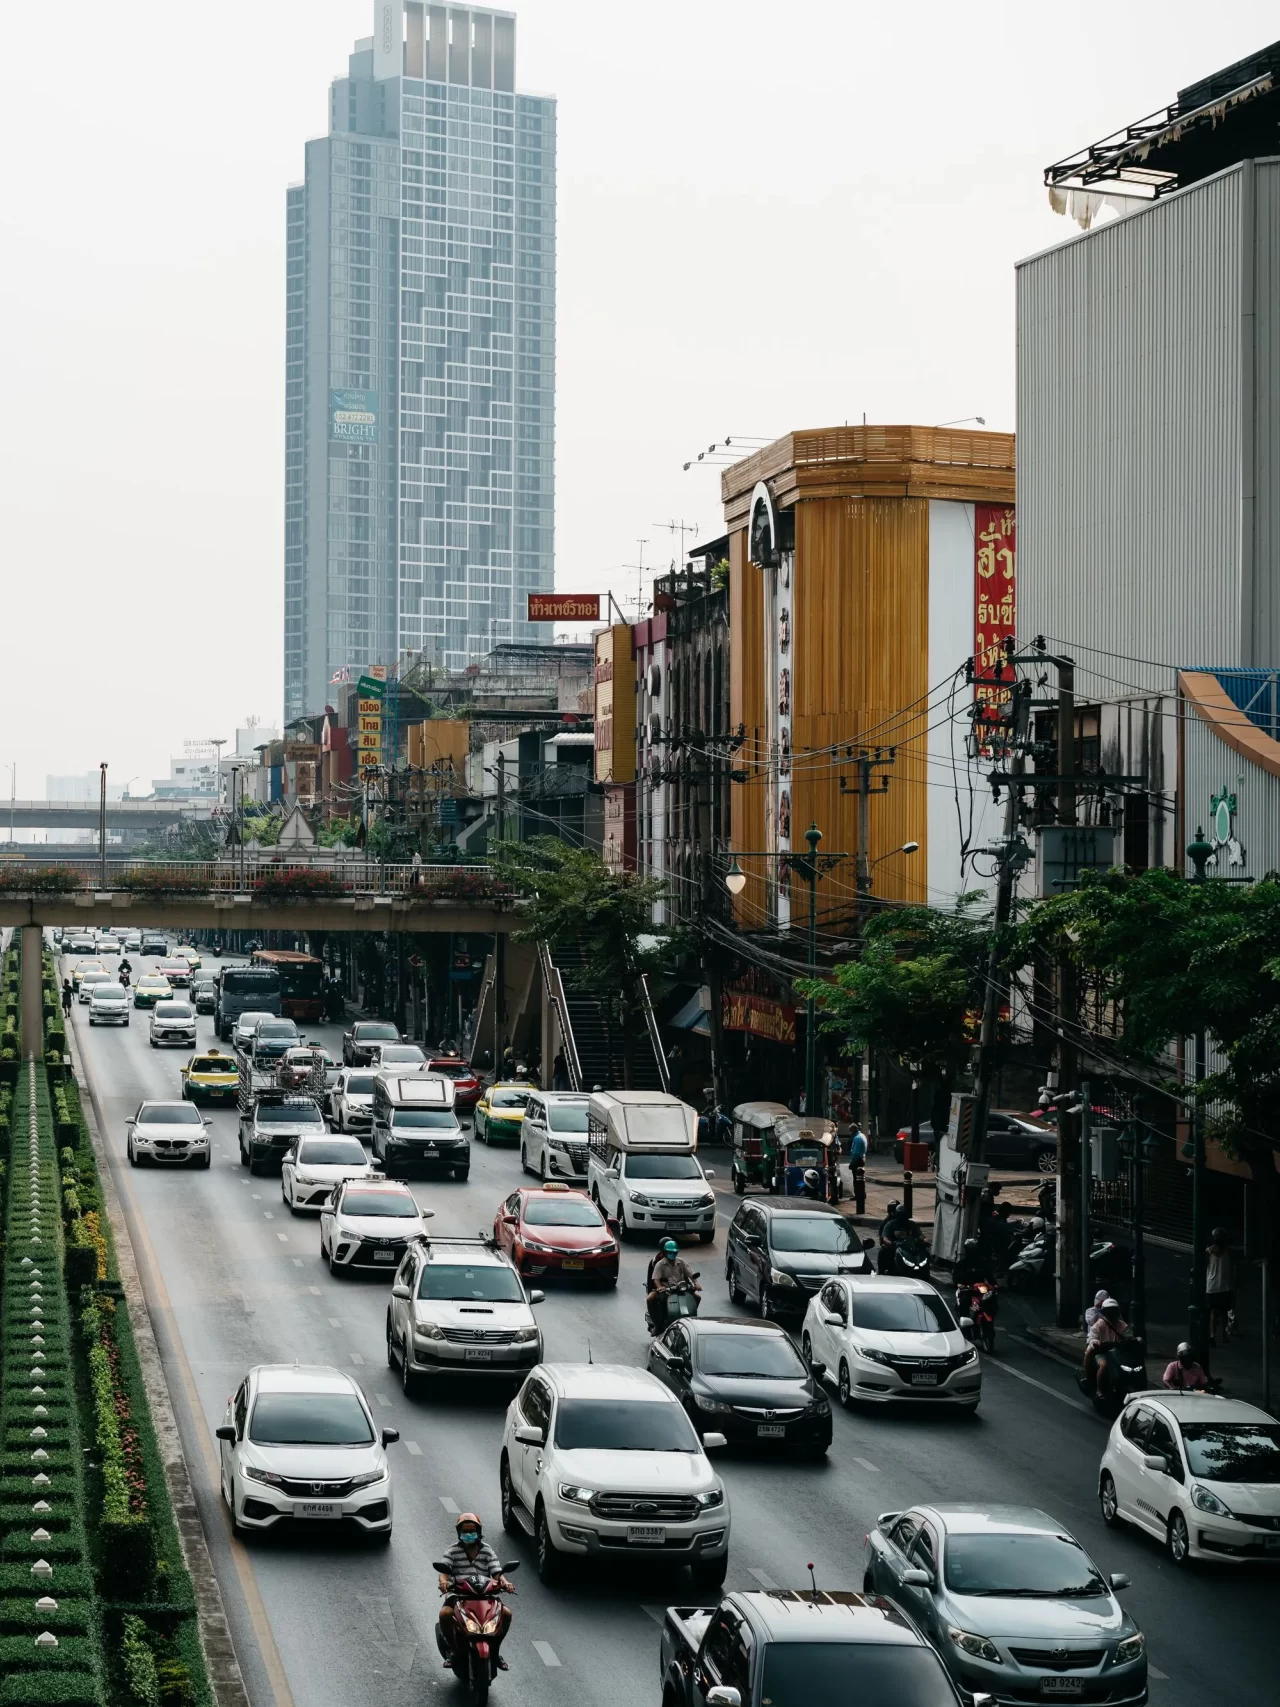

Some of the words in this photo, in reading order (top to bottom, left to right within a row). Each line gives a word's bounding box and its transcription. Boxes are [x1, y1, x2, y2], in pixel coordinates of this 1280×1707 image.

[333, 423, 376, 436] BRIGHT
[977, 522, 1016, 580] ฮั่ว
[360, 701, 380, 712] เมือง
[361, 718, 379, 730] ไทย
[646, 1527, 664, 1535] 3387
[1059, 1678, 1081, 1688] 9242
